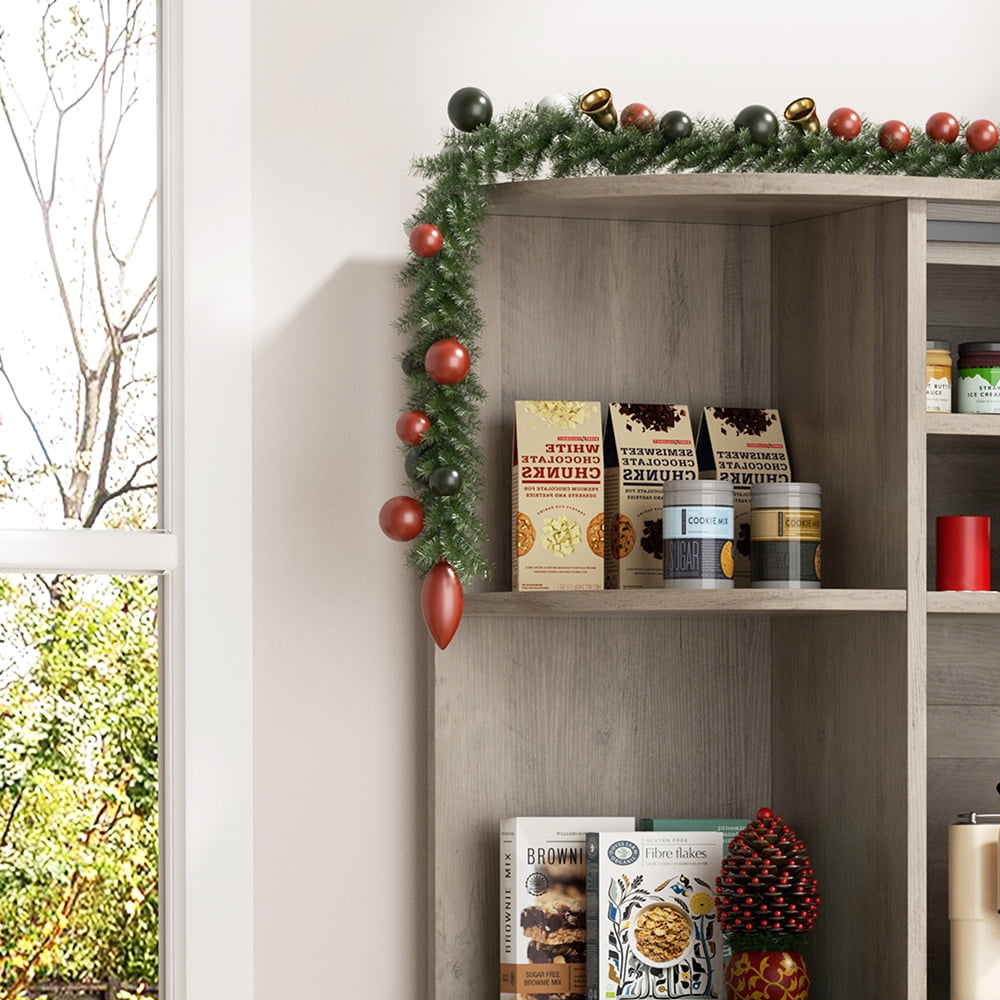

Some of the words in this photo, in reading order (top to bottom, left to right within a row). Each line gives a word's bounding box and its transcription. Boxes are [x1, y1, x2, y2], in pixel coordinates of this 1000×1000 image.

[688, 516, 717, 525] COOKIE
[645, 847, 673, 859] Fibre
[675, 846, 708, 859] flakes
[504, 853, 513, 879] MIX
[504, 887, 513, 954] BROWNIE
[525, 971, 545, 979] SUGAR
[524, 979, 550, 987] BROWNIE
